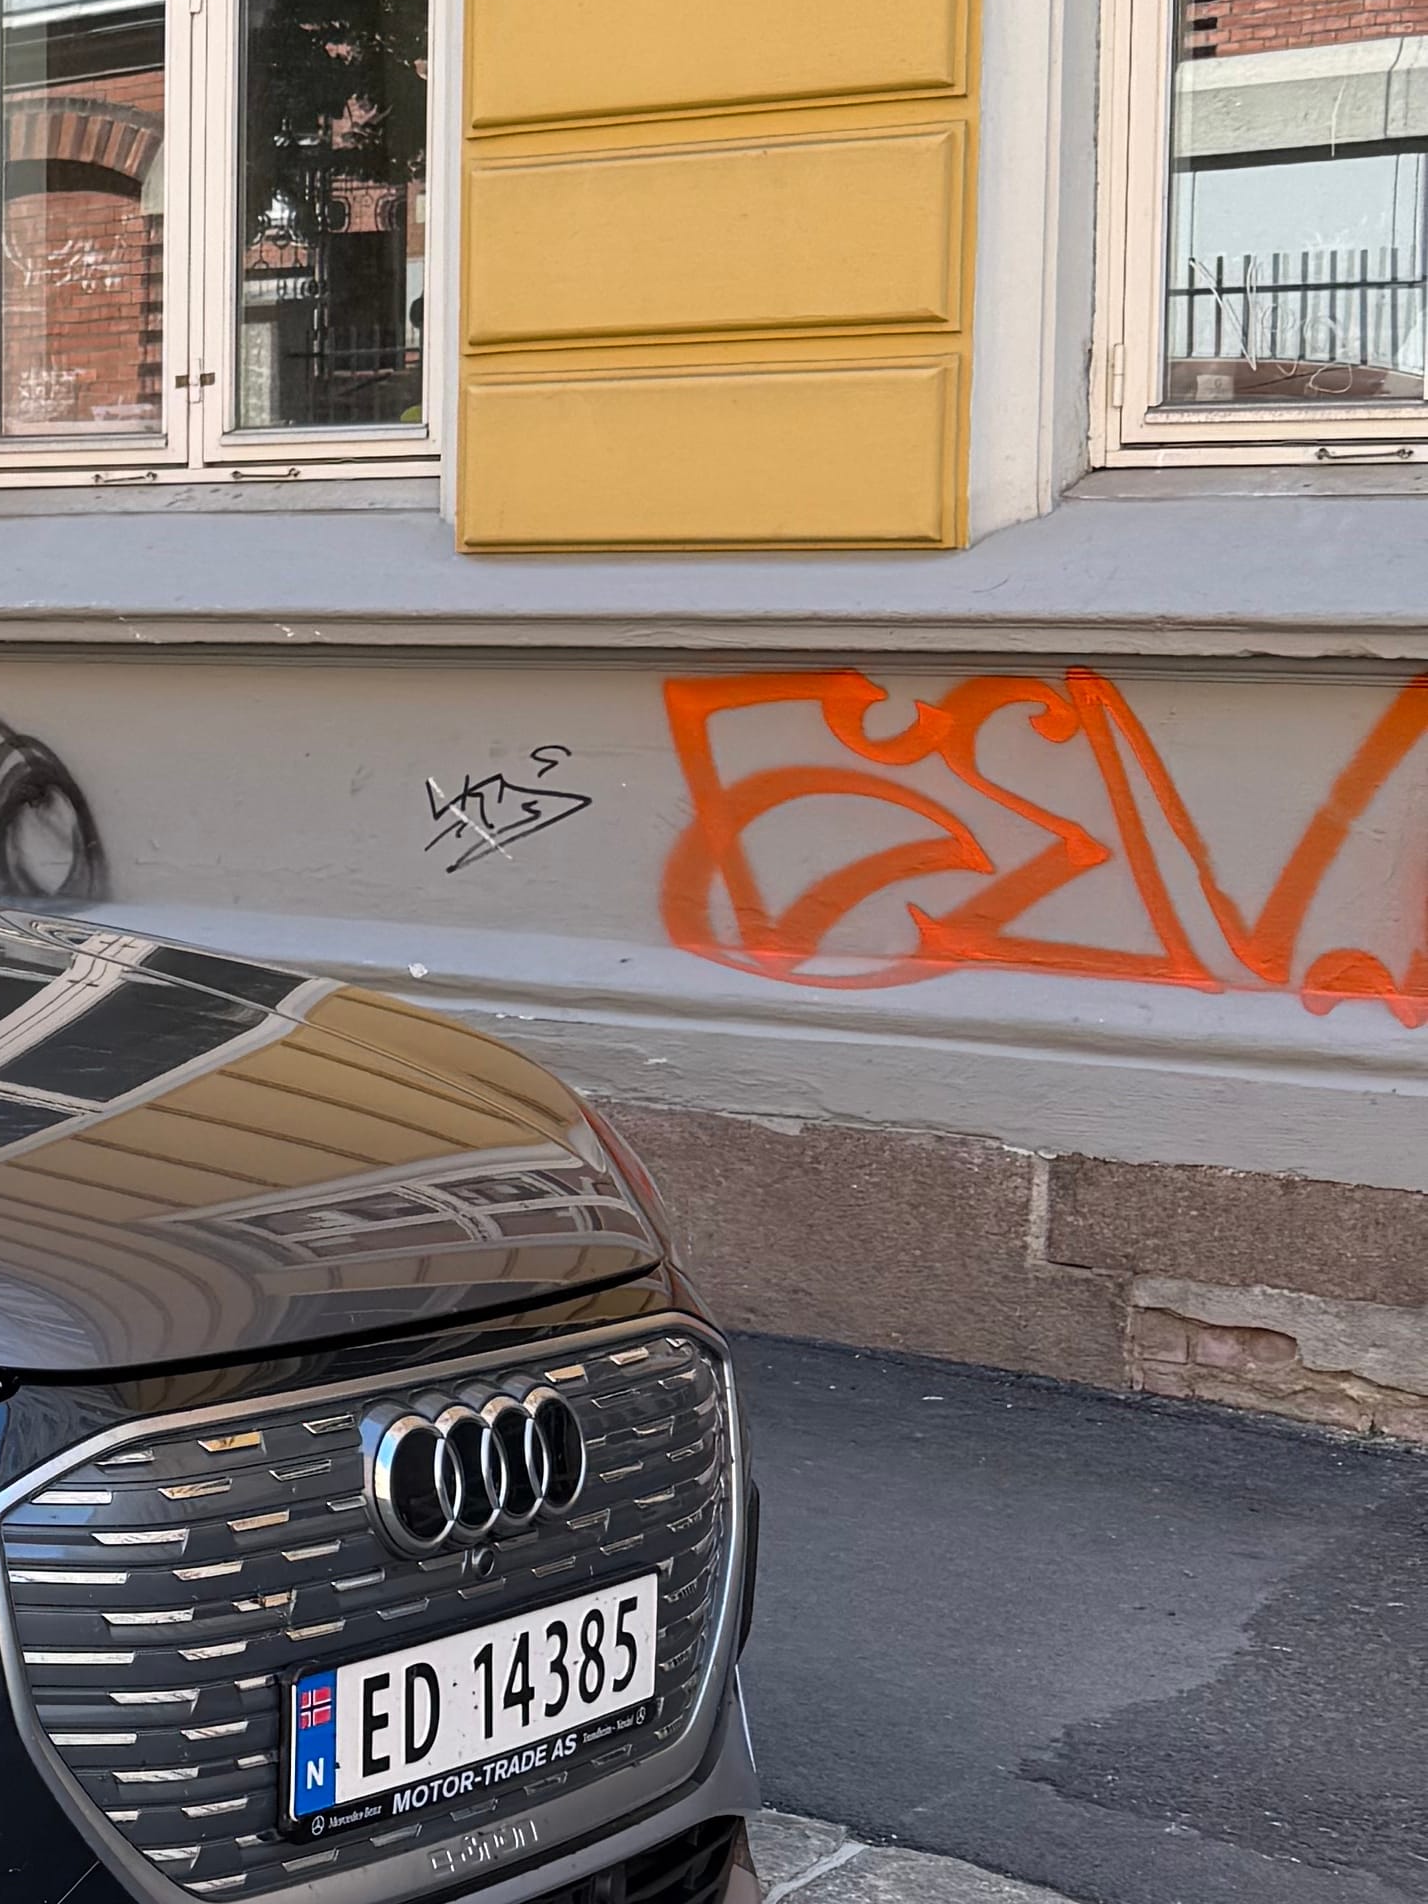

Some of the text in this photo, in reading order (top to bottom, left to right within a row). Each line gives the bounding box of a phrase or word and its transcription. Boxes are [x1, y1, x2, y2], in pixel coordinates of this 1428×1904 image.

[362, 1595, 639, 1779] ED 14385
[306, 1757, 325, 1790] N
[392, 1733, 578, 1815] MOTOR-TRADE AS
